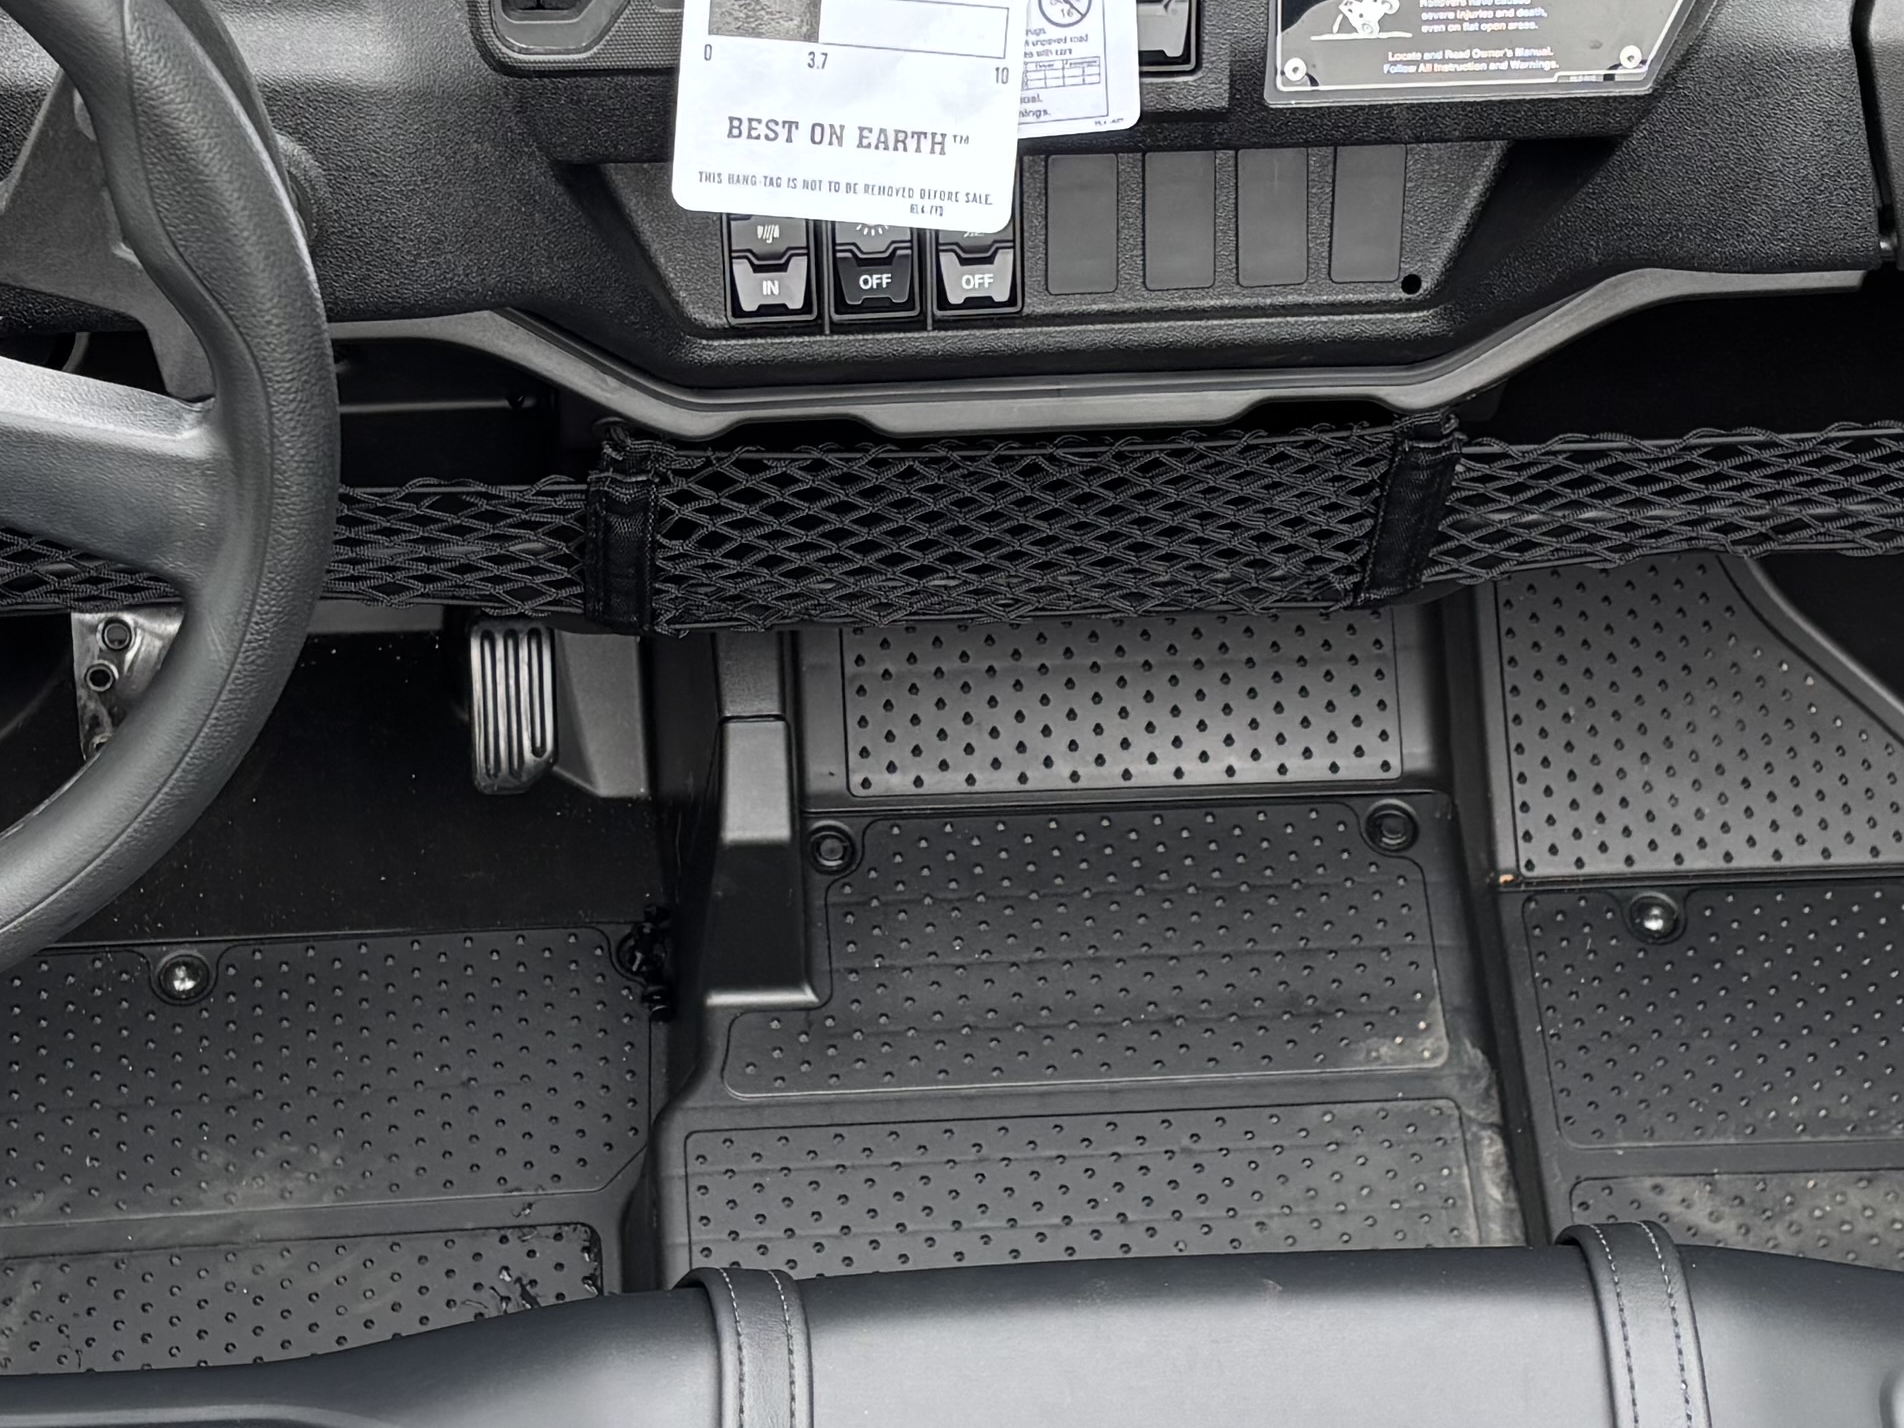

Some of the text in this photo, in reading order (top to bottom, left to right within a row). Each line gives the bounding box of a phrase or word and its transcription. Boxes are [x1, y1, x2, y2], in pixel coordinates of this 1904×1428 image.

[704, 44, 713, 62] 0
[807, 51, 829, 70] 3.7
[994, 66, 1010, 85] 10
[726, 115, 799, 143] BEST
[809, 122, 845, 147] ON
[698, 171, 722, 184] THIS
[787, 177, 797, 189] IS
[802, 178, 822, 191] NOT
[827, 180, 840, 193] TO
[761, 277, 780, 297] IN
[858, 271, 891, 291] OFF
[961, 271, 993, 291] OFF
